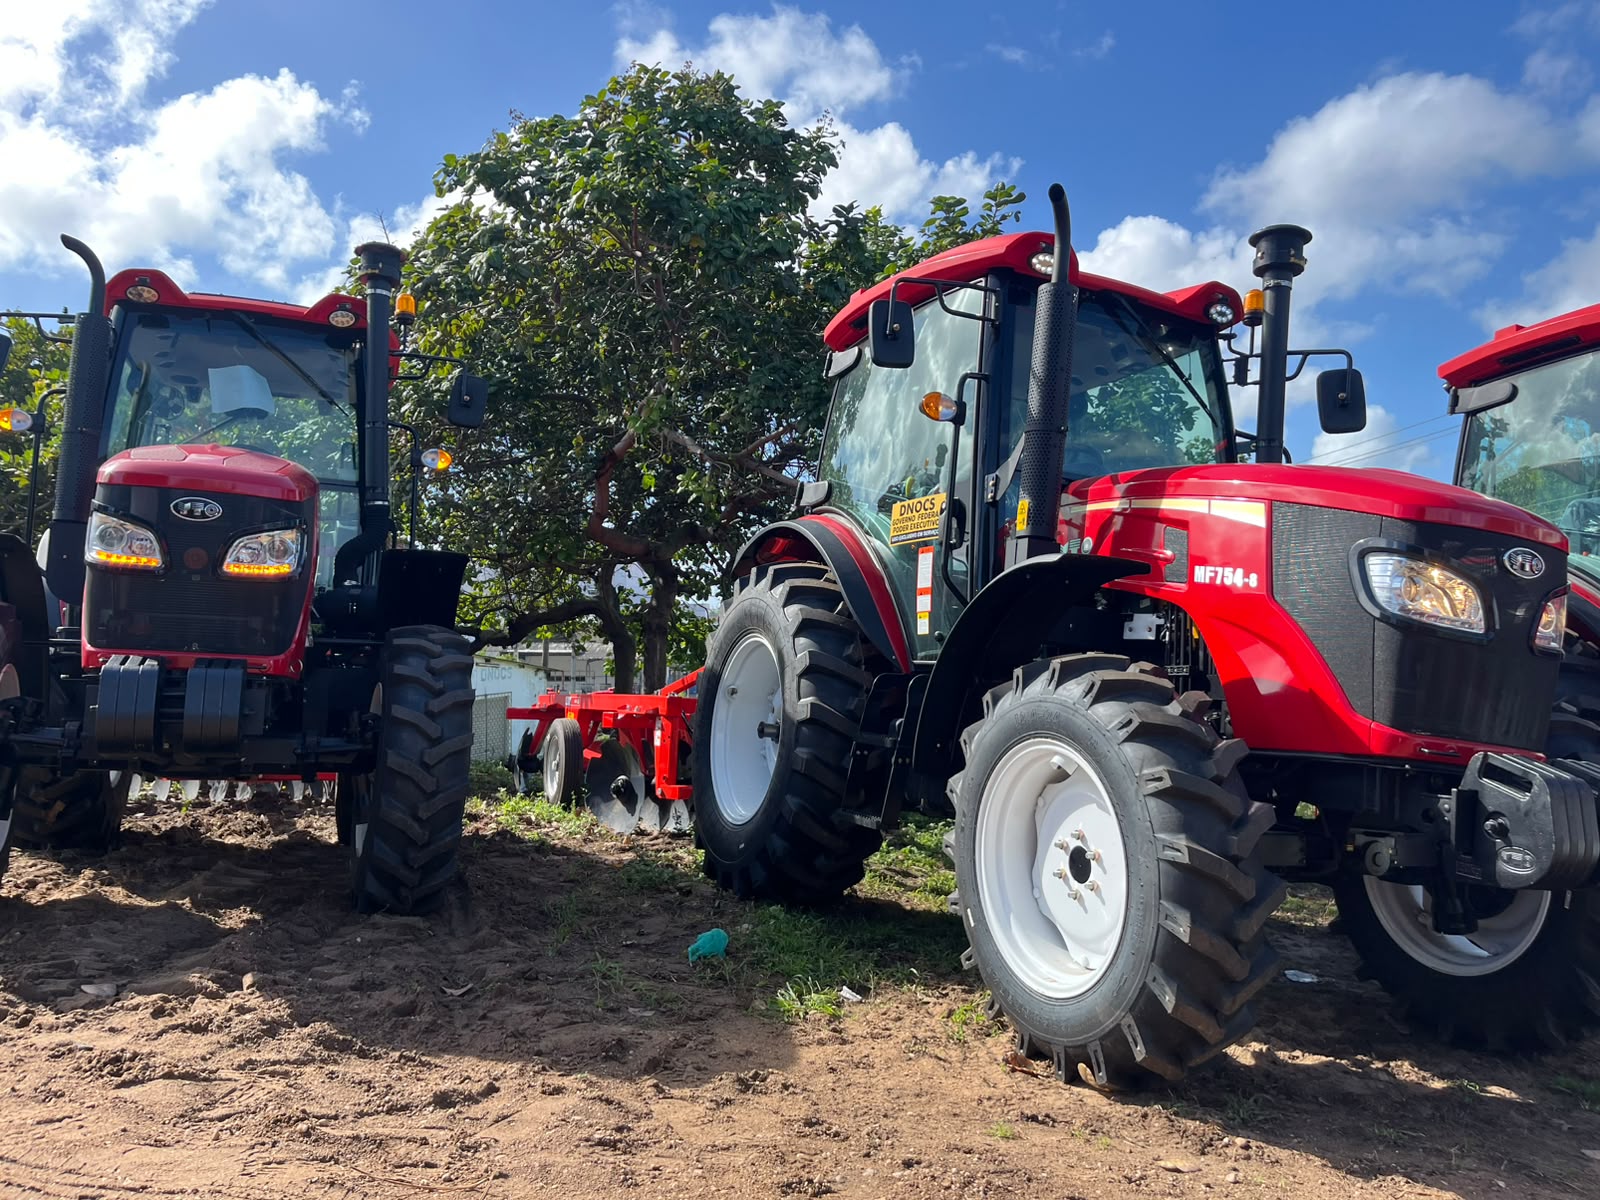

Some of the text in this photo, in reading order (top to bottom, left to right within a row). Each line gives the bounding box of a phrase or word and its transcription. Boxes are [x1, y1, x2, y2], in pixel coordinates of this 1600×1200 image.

[899, 497, 935, 517] DNOCS
[892, 510, 939, 526] GOVERNO FEDERA
[892, 524, 909, 534] PODER
[480, 666, 513, 681] DNOCS
